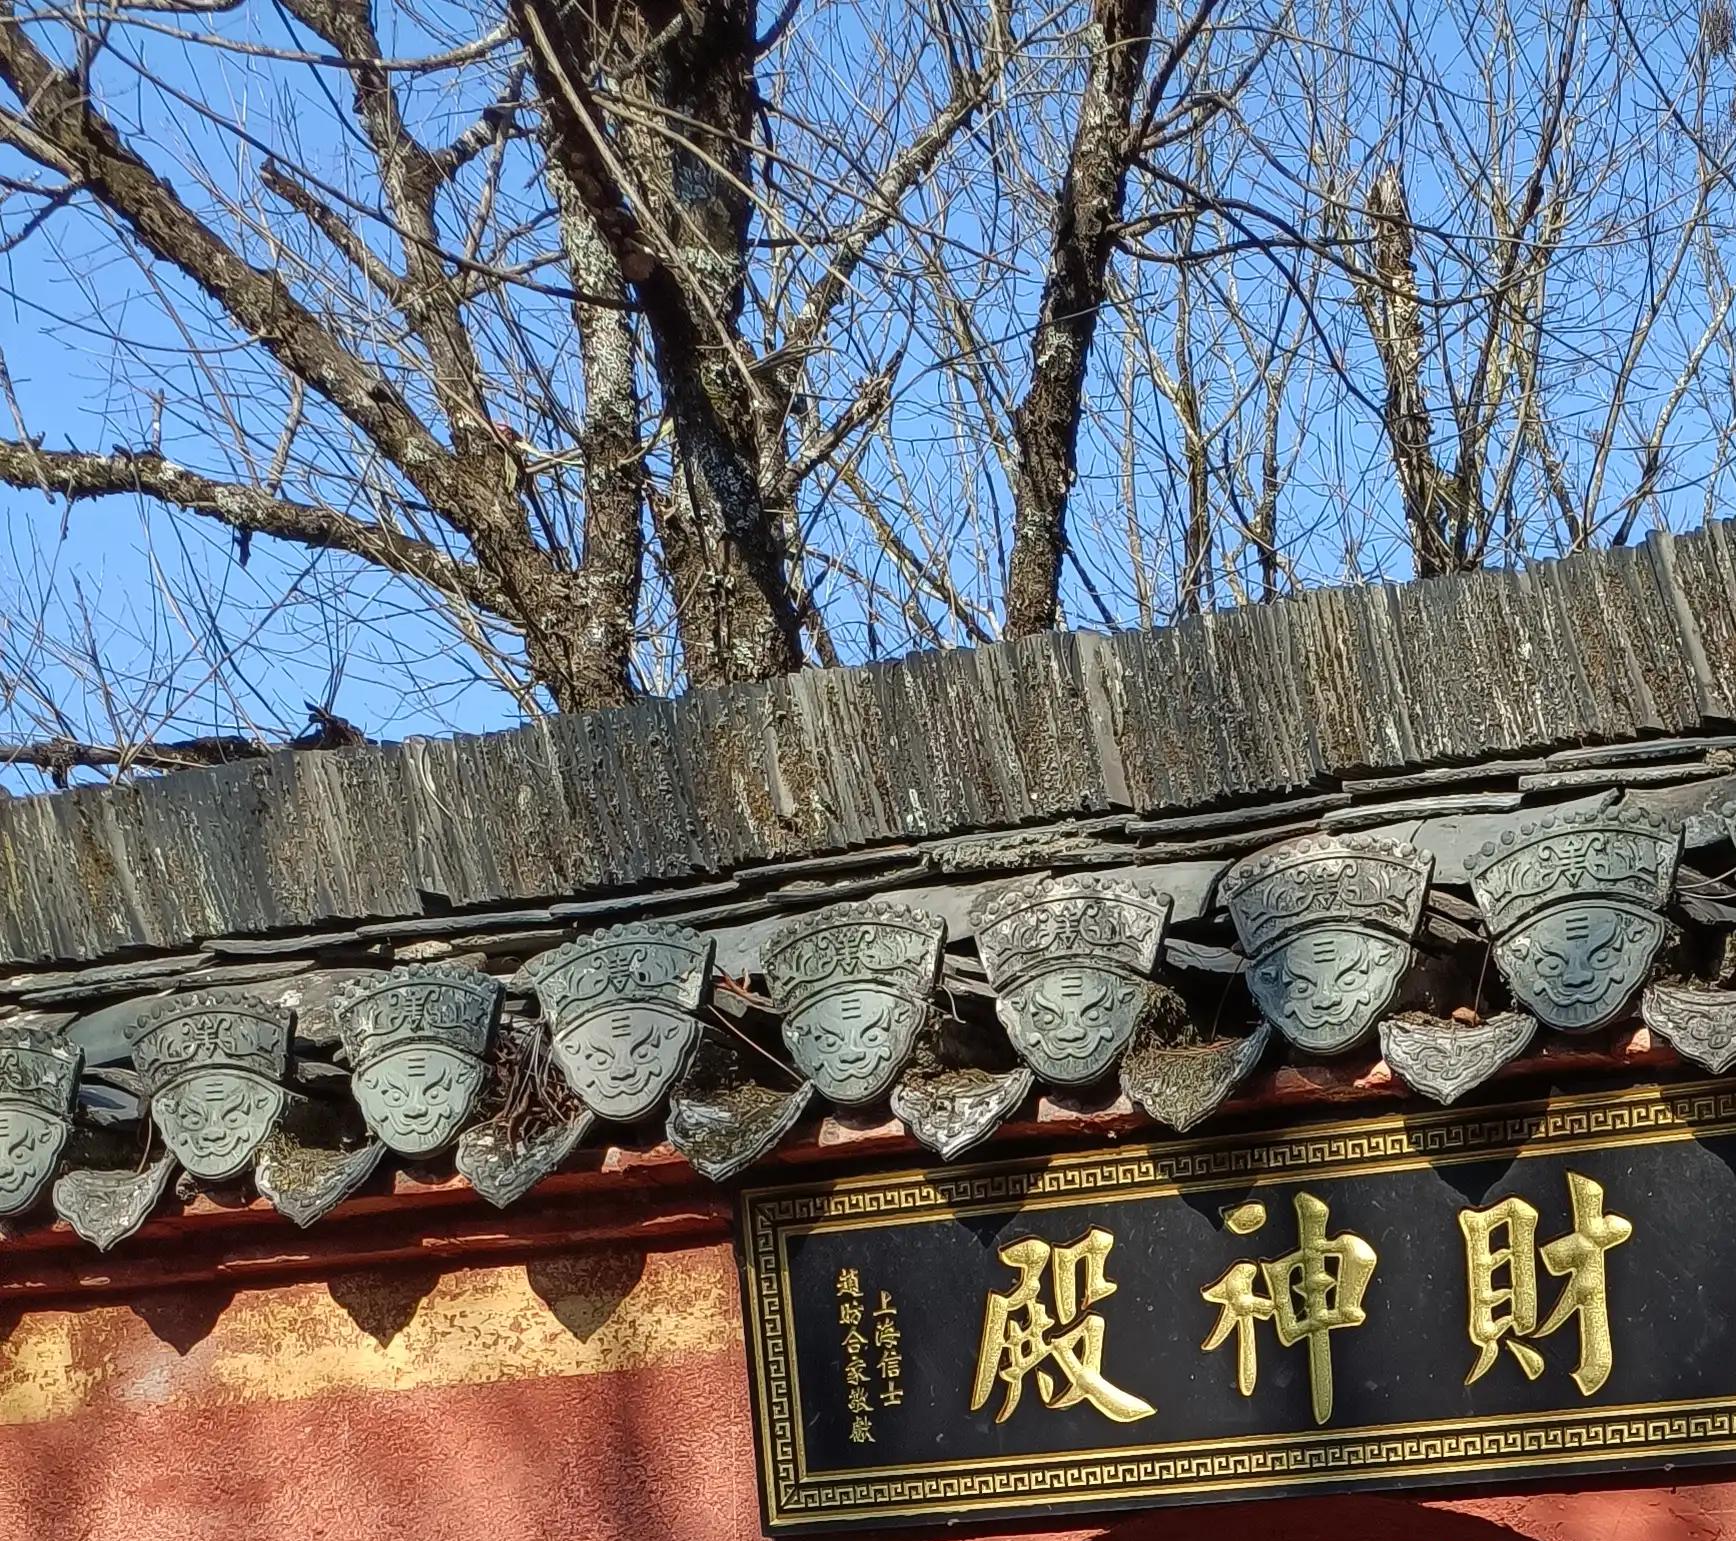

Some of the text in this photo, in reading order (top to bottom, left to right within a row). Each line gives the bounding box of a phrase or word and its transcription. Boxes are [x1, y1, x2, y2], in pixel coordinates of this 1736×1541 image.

[873, 1289, 904, 1407] 上海信士
[968, 1168, 1635, 1425] 財神殿
